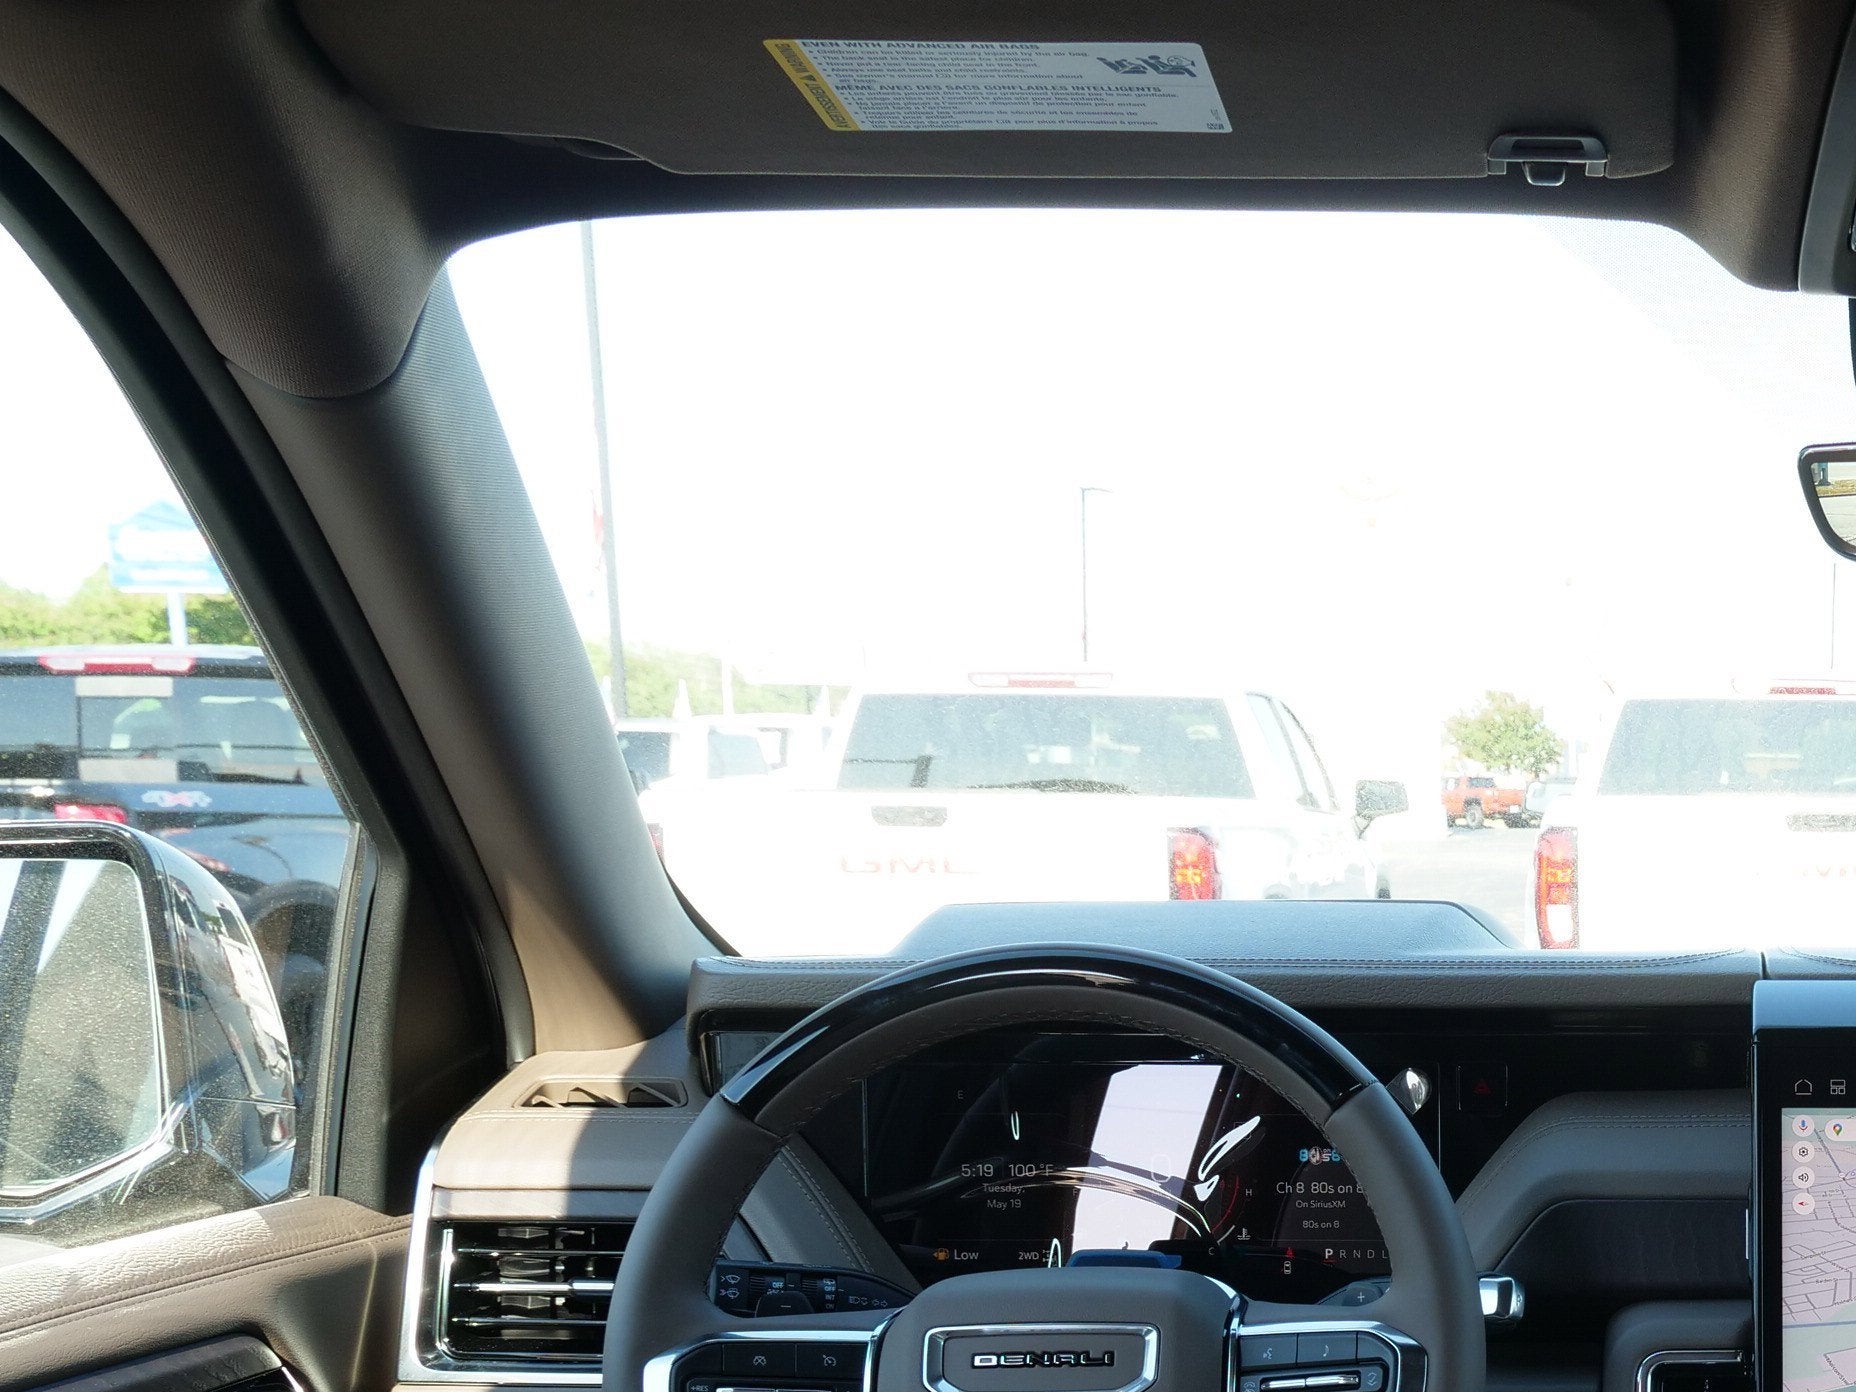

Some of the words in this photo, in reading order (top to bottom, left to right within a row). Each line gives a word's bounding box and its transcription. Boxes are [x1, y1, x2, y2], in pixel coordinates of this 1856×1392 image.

[961, 1164, 994, 1177] 5:19
[1009, 1164, 1036, 1177] 100
[1276, 1182, 1293, 1194] Ch
[1296, 1182, 1305, 1194] 8
[1311, 1182, 1335, 1194] 80s
[1337, 1185, 1353, 1194] on
[987, 1200, 1008, 1211] May
[1010, 1200, 1022, 1209] 19
[1295, 1200, 1309, 1209] On
[1310, 1200, 1347, 1209] SiriusXM
[1302, 1220, 1319, 1229] 80s
[1333, 1220, 1340, 1229] 8
[954, 1249, 979, 1261] Low
[1018, 1251, 1040, 1261] 2WD
[1325, 1248, 1334, 1259] P
[1339, 1249, 1347, 1259] R
[1353, 1249, 1361, 1259] N
[1367, 1249, 1375, 1259] D
[972, 1350, 1115, 1369] DENALI
